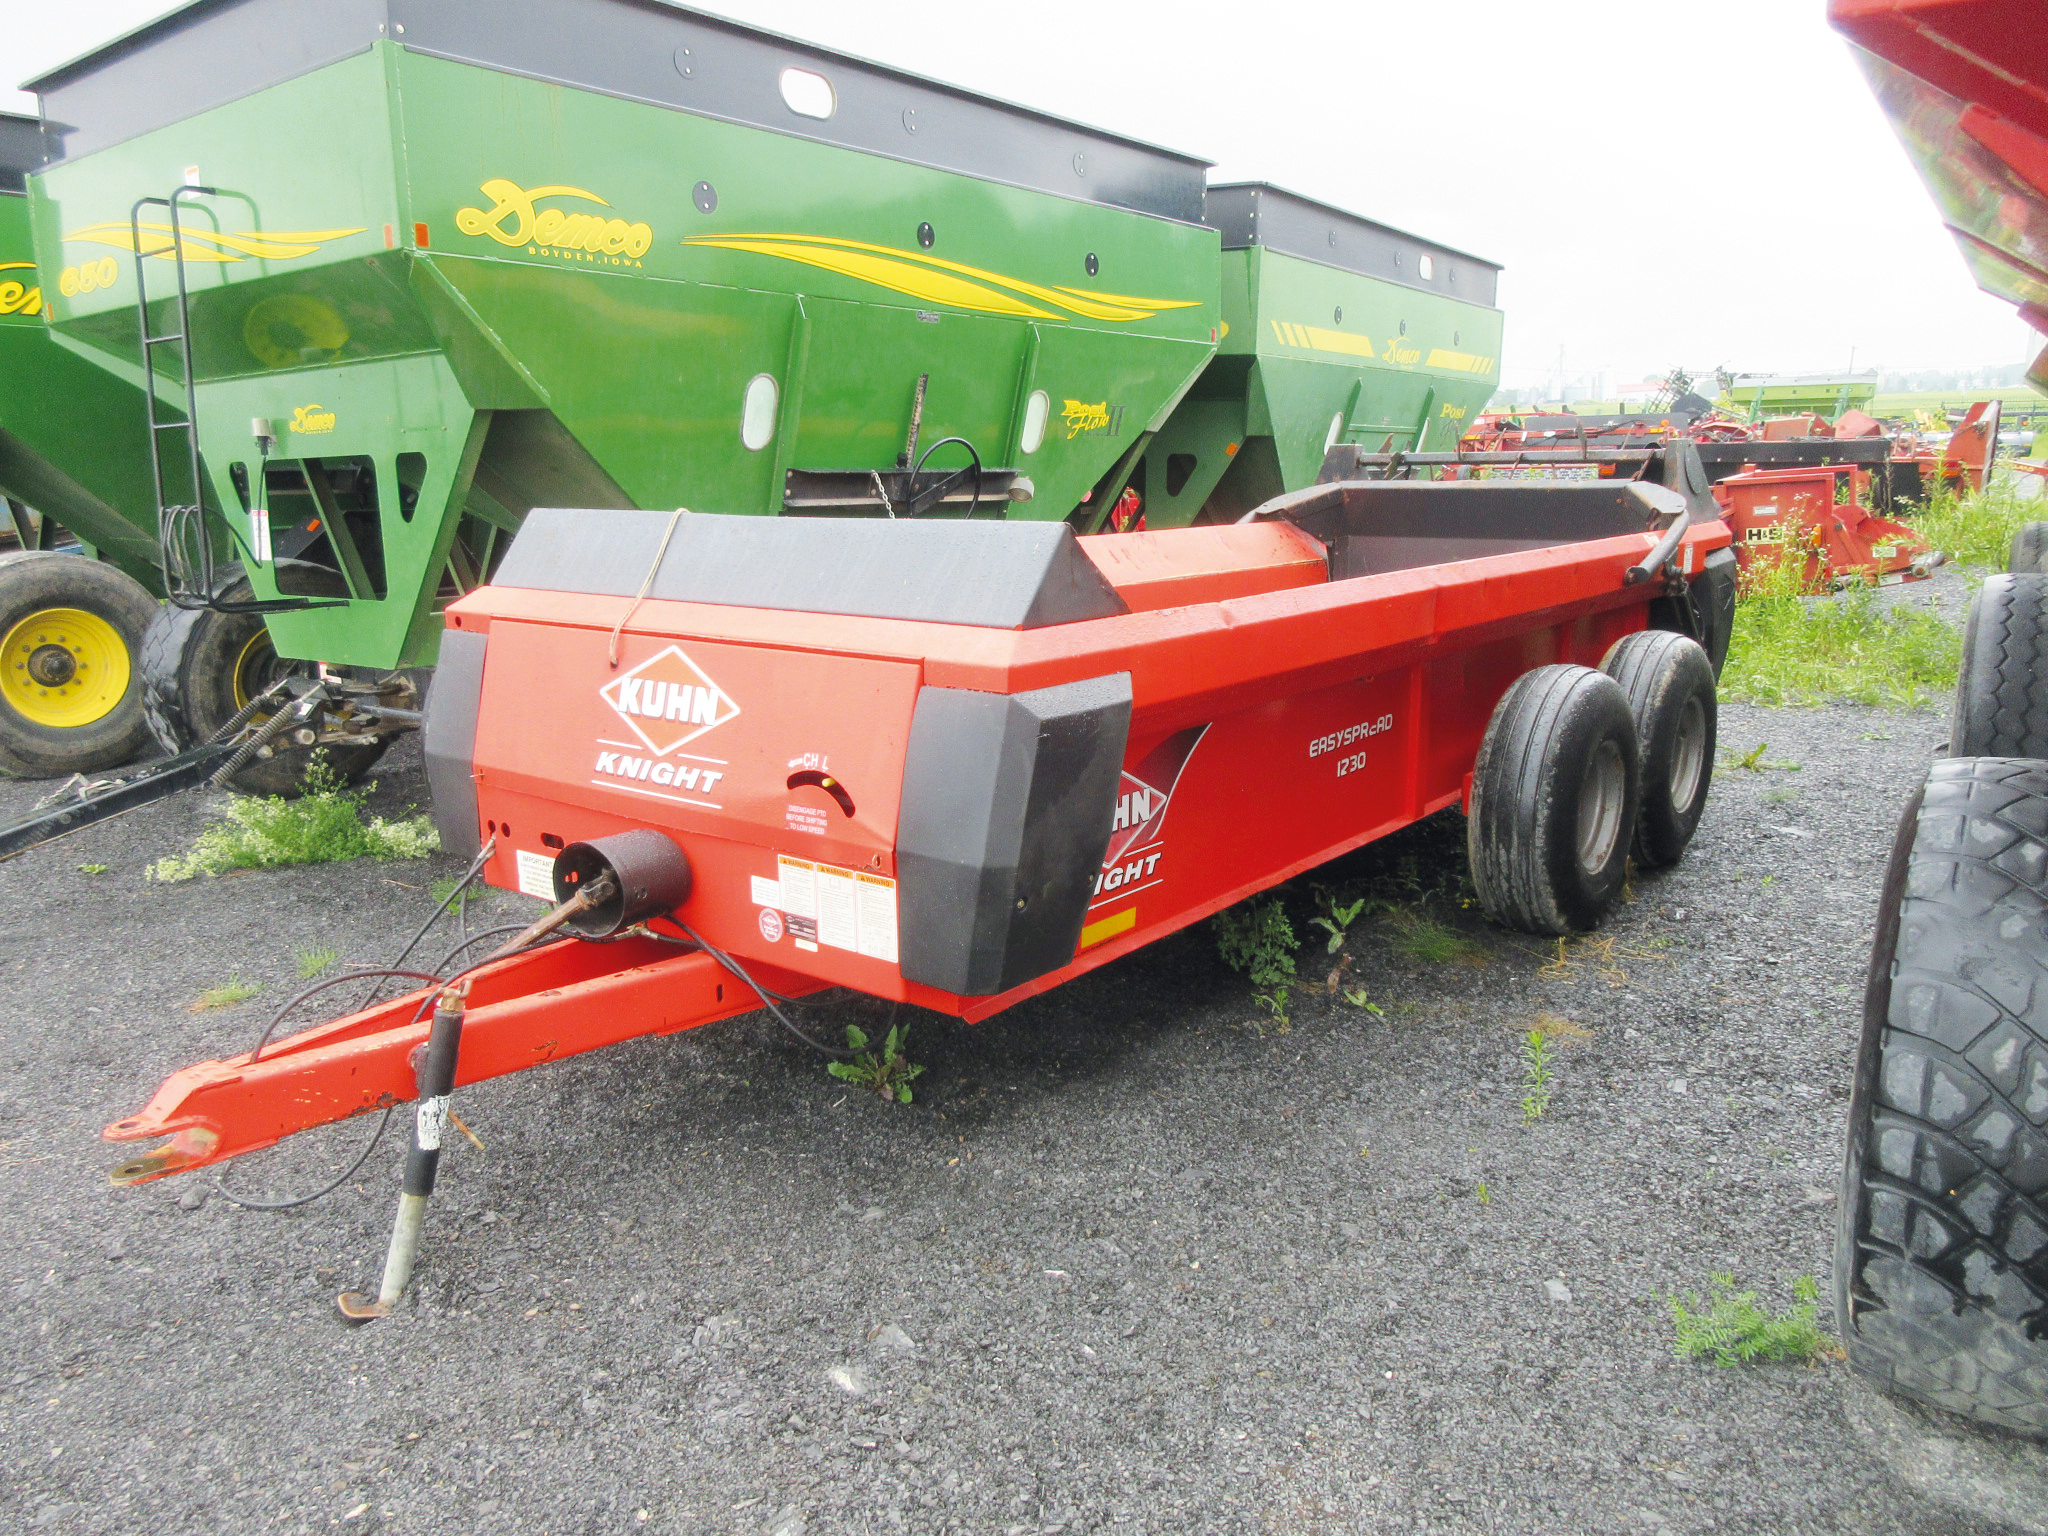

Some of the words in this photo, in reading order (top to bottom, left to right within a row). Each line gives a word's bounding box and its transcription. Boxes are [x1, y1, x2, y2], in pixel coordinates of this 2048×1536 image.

[455, 178, 653, 259] Demco
[59, 256, 118, 297] 650
[289, 404, 336, 433] Demco
[1060, 400, 1107, 417] Posi
[1440, 403, 1467, 419] Posi
[1066, 413, 1110, 439] Flow
[618, 676, 719, 726] KUHN
[595, 751, 723, 794] KNIGHT
[1337, 751, 1367, 778] 1230
[785, 813, 806, 823] BEFORE
[806, 816, 828, 827] SHIFTING
[788, 804, 816, 816] DISENGAGE
[817, 809, 827, 818] PTO
[1112, 786, 1151, 833] HN
[790, 822, 797, 830] TO
[797, 824, 808, 832] LOW
[808, 825, 825, 835] SPEED
[522, 855, 553, 869] IMPORTANT
[787, 860, 810, 870] WARNING
[826, 867, 849, 878] WARNING
[865, 875, 890, 887] WARNING
[1094, 852, 1162, 897] IGHT
